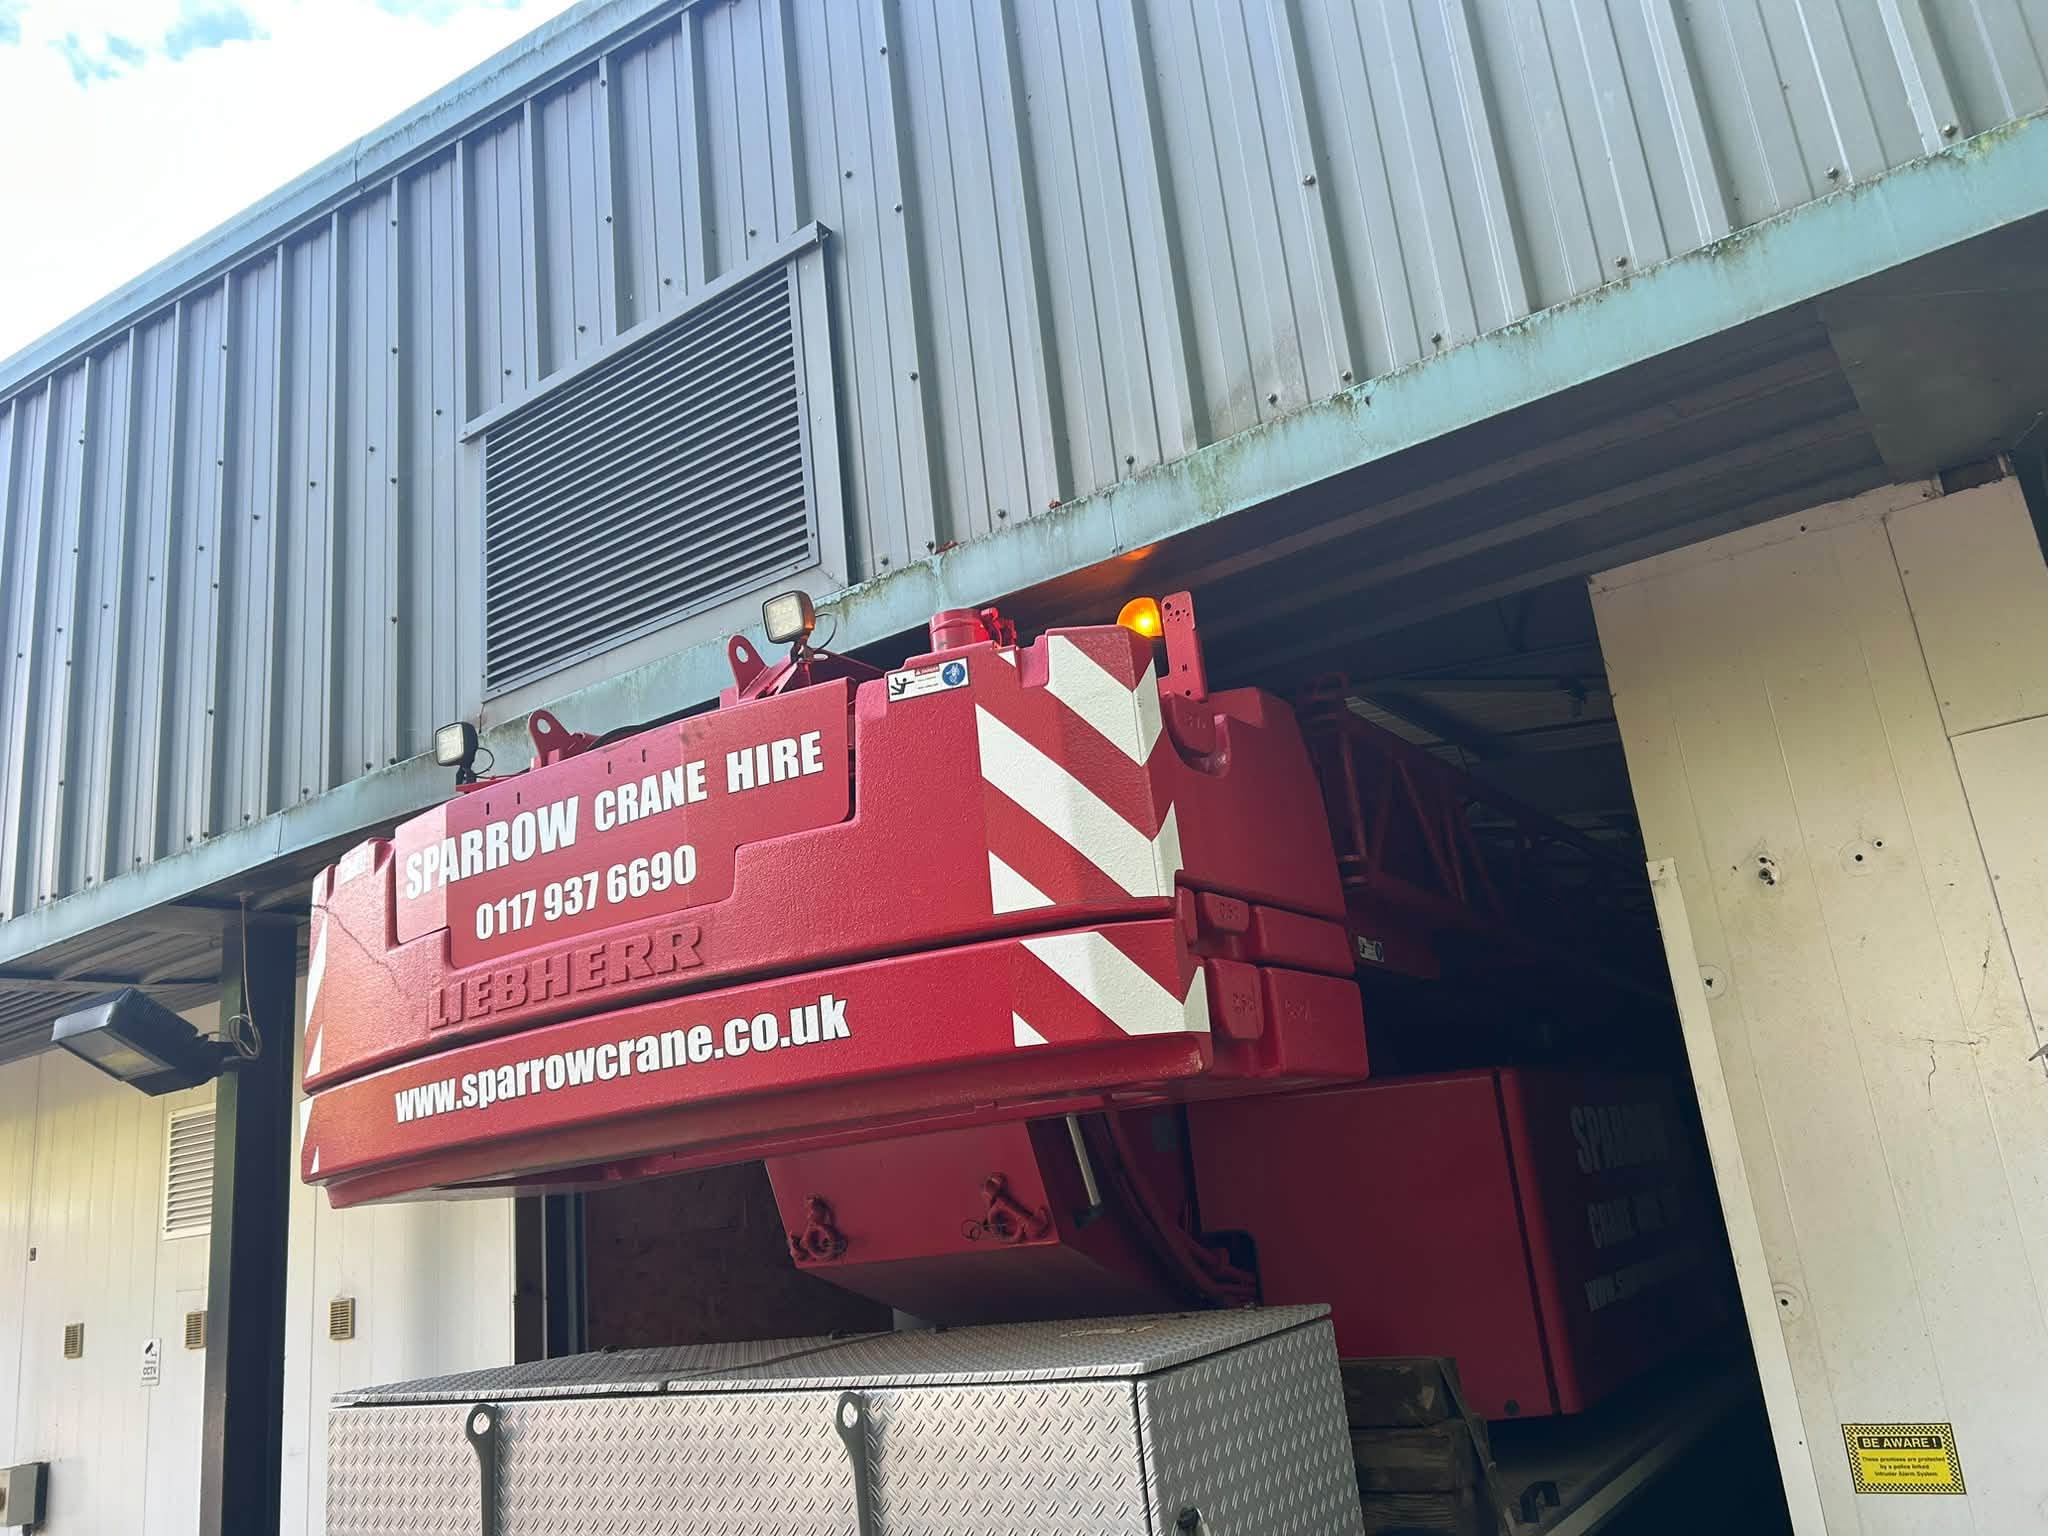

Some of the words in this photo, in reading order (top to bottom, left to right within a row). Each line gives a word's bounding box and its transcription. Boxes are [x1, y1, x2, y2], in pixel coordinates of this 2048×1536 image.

[405, 795, 579, 900] SPARROW
[593, 759, 708, 832] CRANE
[726, 730, 824, 794] HIRE
[475, 889, 537, 940] 0117
[543, 871, 599, 922] 937
[606, 844, 697, 904] 6690
[428, 925, 705, 1030] LIEBHERR
[394, 993, 851, 1124] www.sparrowcrane.co.uk
[142, 1366, 157, 1376] CCTV
[1862, 1438, 1880, 1448] BE
[1883, 1437, 1929, 1448] AWARE
